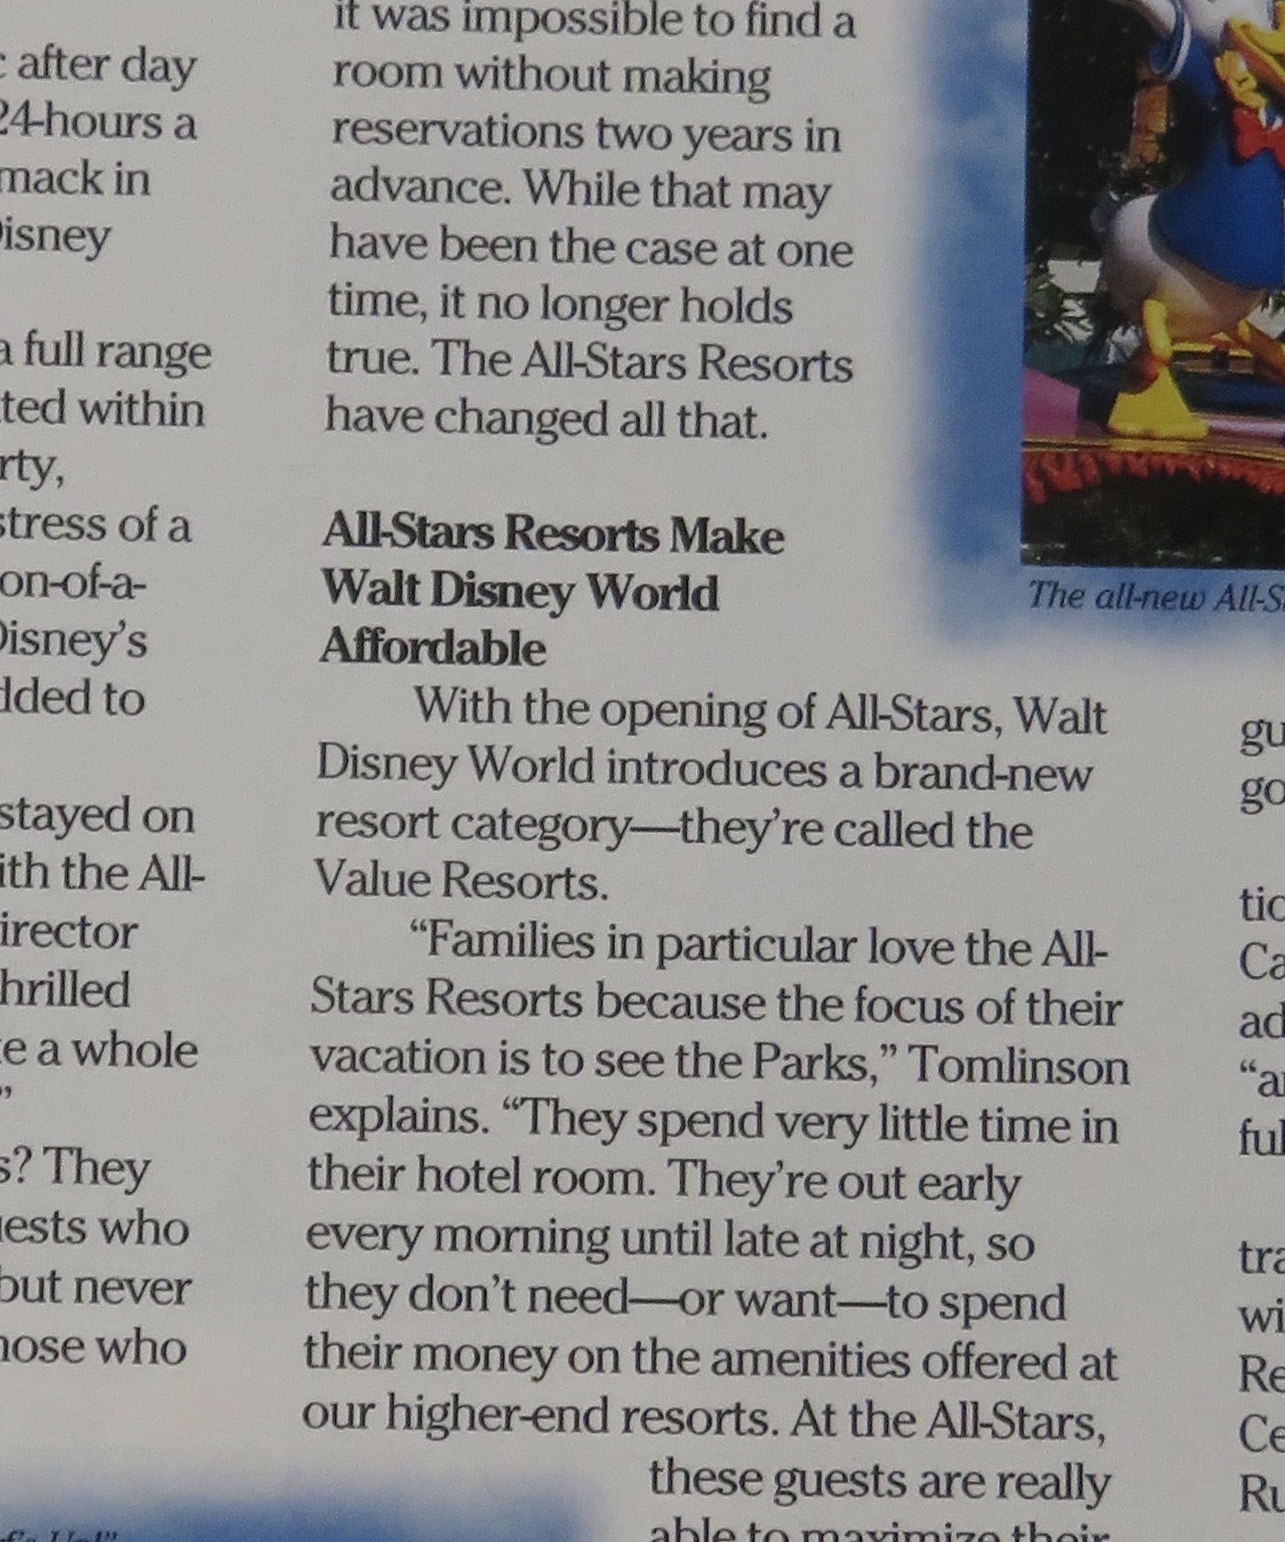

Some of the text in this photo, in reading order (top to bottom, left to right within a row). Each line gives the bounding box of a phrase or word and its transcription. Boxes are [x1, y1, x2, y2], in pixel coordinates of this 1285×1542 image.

[333, 54, 771, 104] room without making
[24, 328, 84, 367] full
[97, 341, 212, 379] range
[326, 338, 854, 383] true. The All-Stars Resorts
[321, 509, 785, 555] All-Stars Resorts Make
[321, 567, 720, 619] Walt Disney World
[1030, 580, 1085, 609] The
[1096, 583, 1205, 611] all-new
[319, 625, 547, 667] Affordable
[103, 682, 145, 716] to
[413, 685, 1108, 739] With the opening of All-Stars, Walt
[314, 858, 608, 901] Value Resorts.
[37, 1039, 62, 1066] a
[71, 1029, 198, 1069] whole
[306, 1217, 1035, 1270] every morning until late at night, so
[74, 1277, 193, 1305] never
